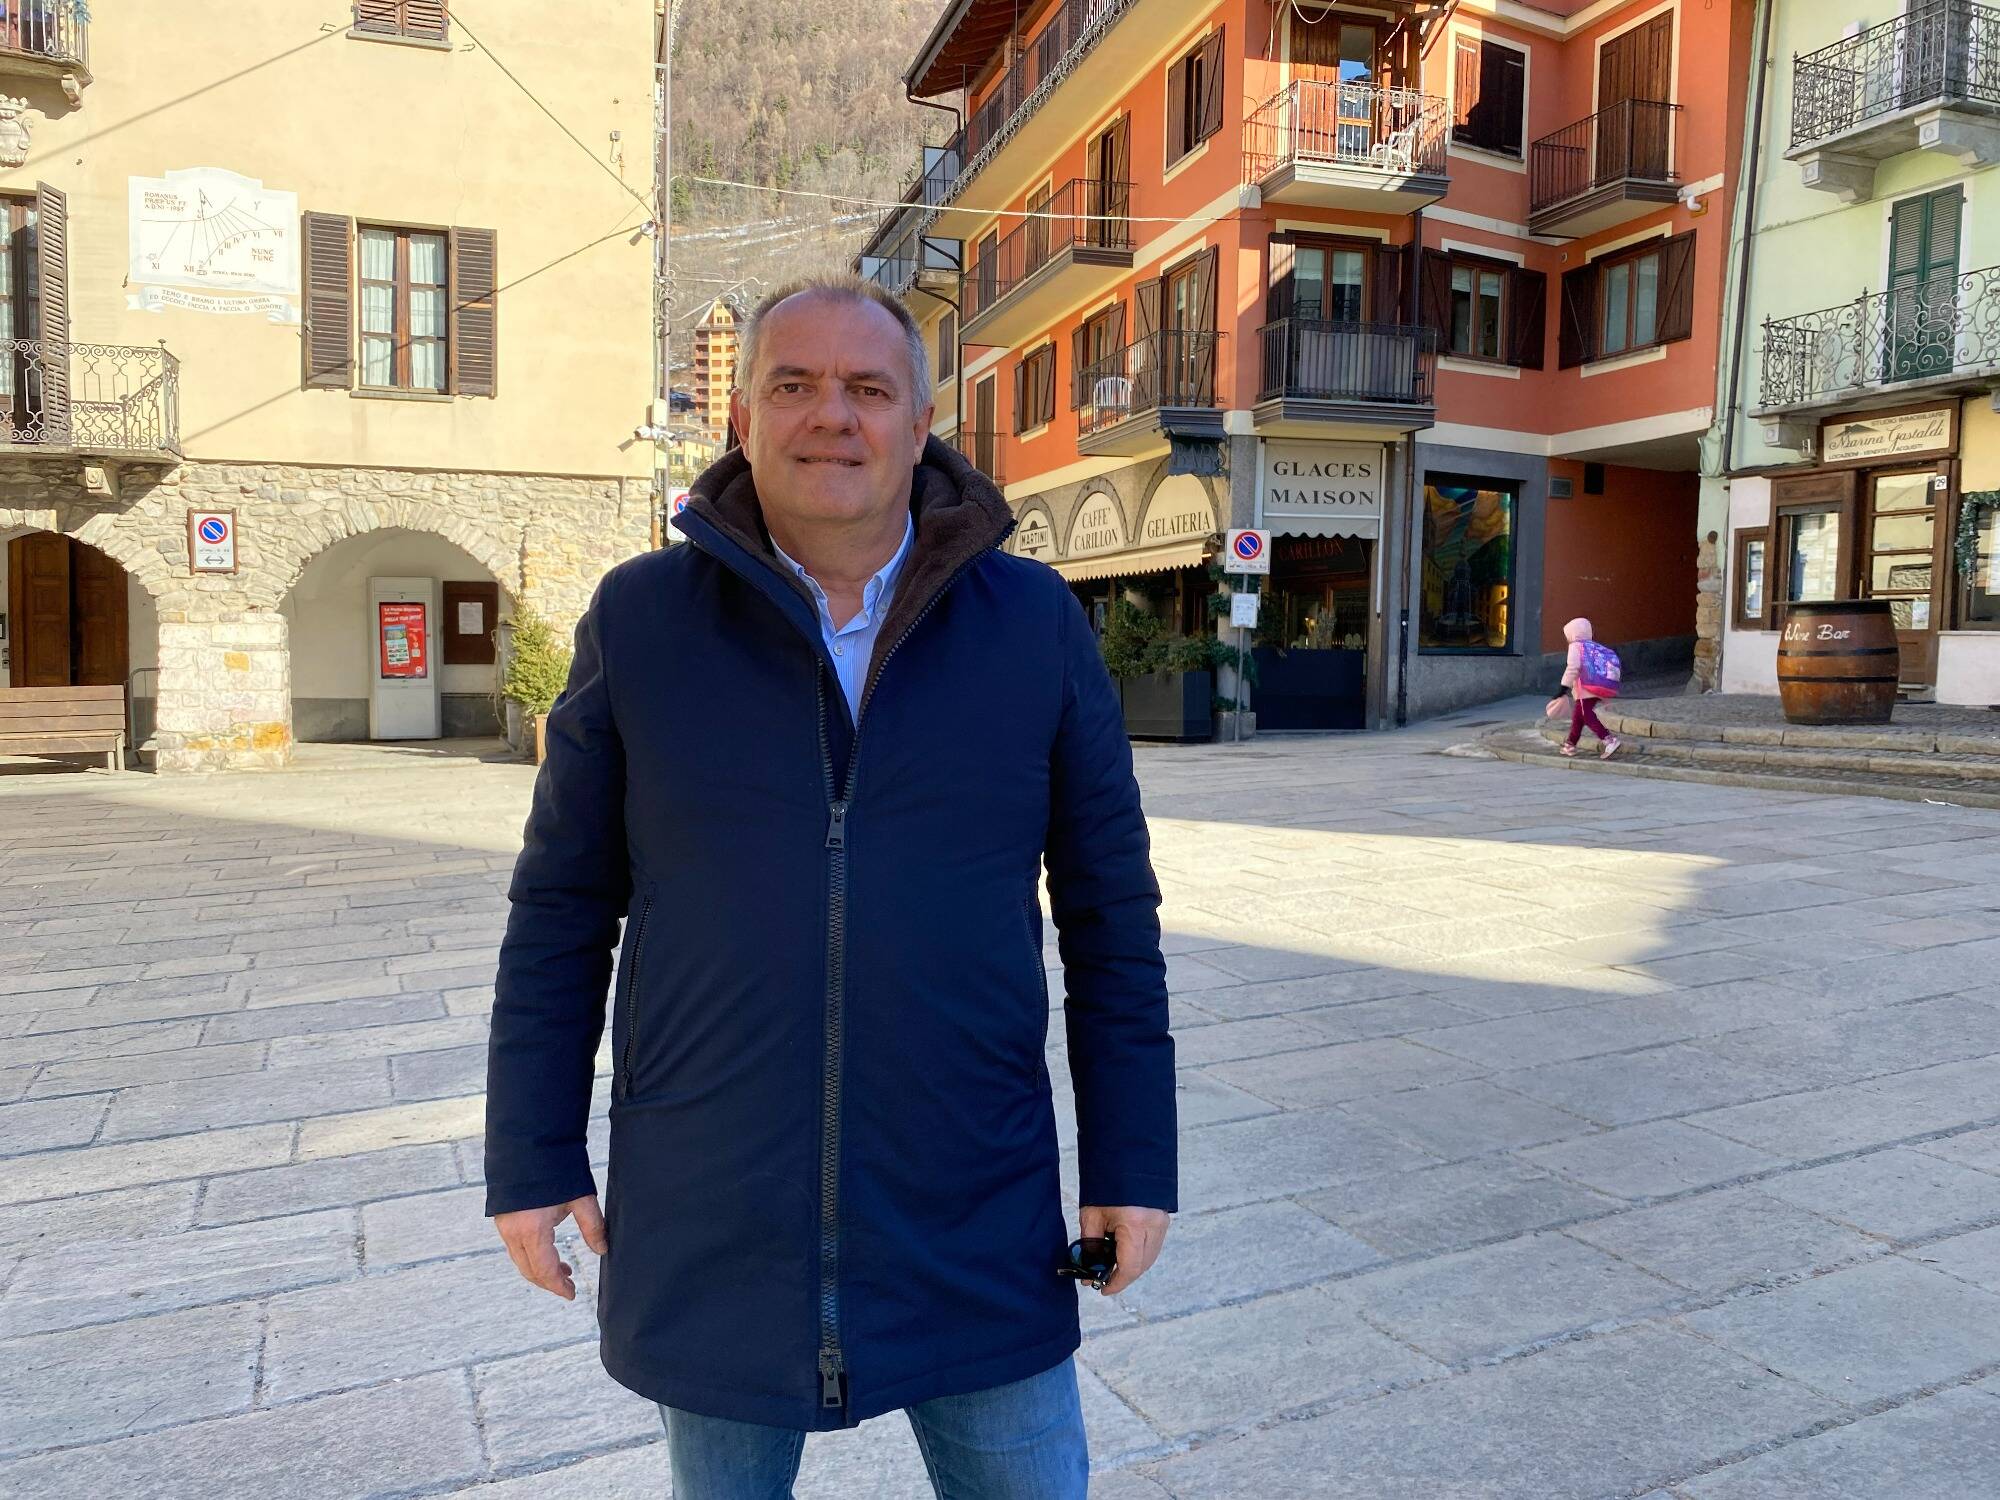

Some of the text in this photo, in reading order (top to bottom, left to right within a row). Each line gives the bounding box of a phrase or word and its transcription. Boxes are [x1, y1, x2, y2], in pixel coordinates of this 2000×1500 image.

[152, 262, 160, 270] XI
[184, 264, 194, 272] XII
[1871, 410, 1946, 426] STUDIO IMMOBILIARE
[1829, 419, 1945, 453] Marina Gastaldi
[1828, 451, 1859, 460] LOCAZIONI
[1894, 444, 1924, 452] ACQUISTI
[1273, 461, 1371, 477] GLACES
[1936, 478, 1946, 487] 29
[1271, 488, 1374, 505] MAISON
[1148, 511, 1211, 538] GELATERIA
[1021, 530, 1048, 546] MARTINI
[1074, 528, 1118, 551] CARILLON
[1784, 623, 1850, 642] Wine Bar
